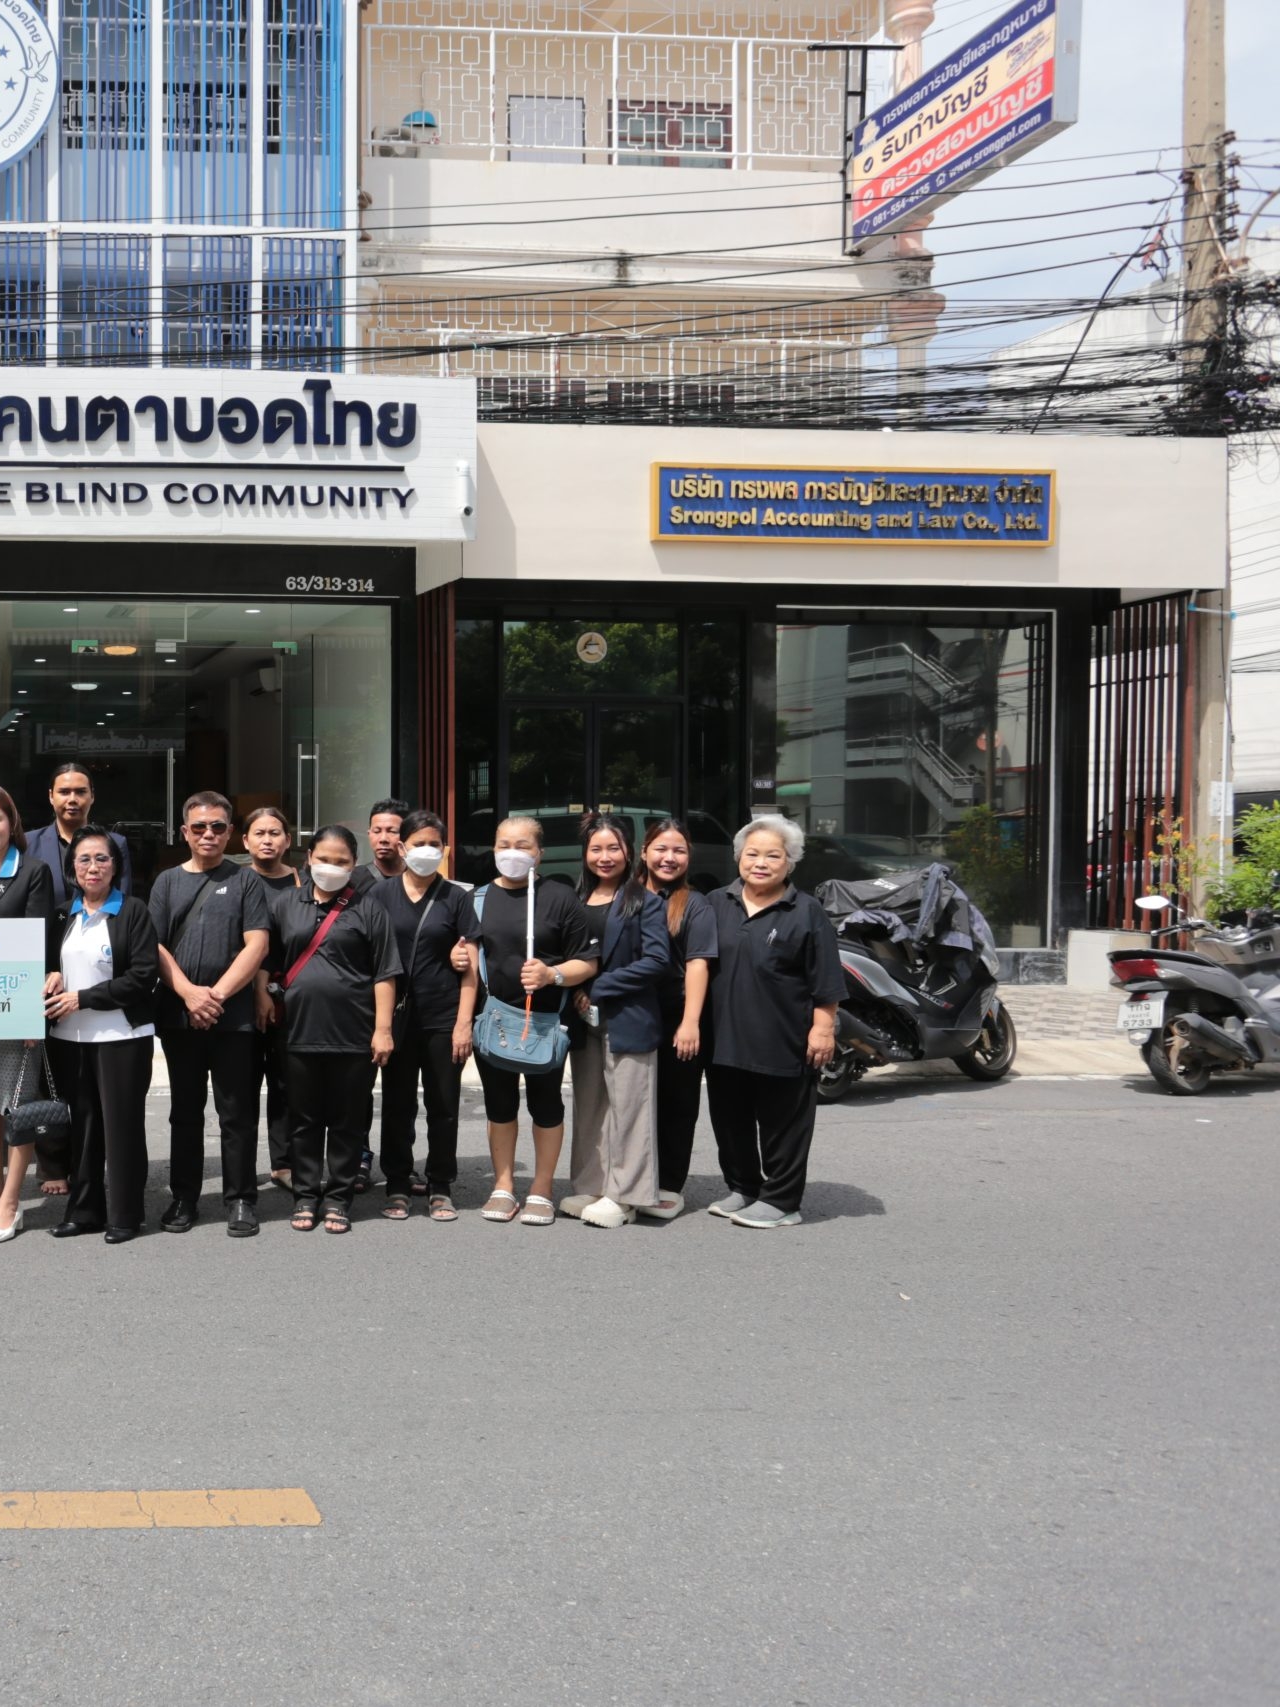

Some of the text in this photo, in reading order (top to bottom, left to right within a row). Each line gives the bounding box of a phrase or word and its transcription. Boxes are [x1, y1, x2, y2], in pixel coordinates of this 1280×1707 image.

[1, 88, 45, 149] COMMUNITY
[881, 65, 1043, 199] ตรวจสอบบัญชี
[882, 65, 989, 163] รับทำบัญชี
[949, 112, 1042, 178] www.srongpol.com
[25, 482, 149, 504] BLIND
[162, 482, 416, 509] COMMUNITY
[670, 473, 724, 498] บริษัท
[730, 479, 799, 500] ทรงพล
[670, 505, 1042, 533] Srongpol Accounting and Law Co., Ltd.
[285, 576, 375, 593] 63/313-314
